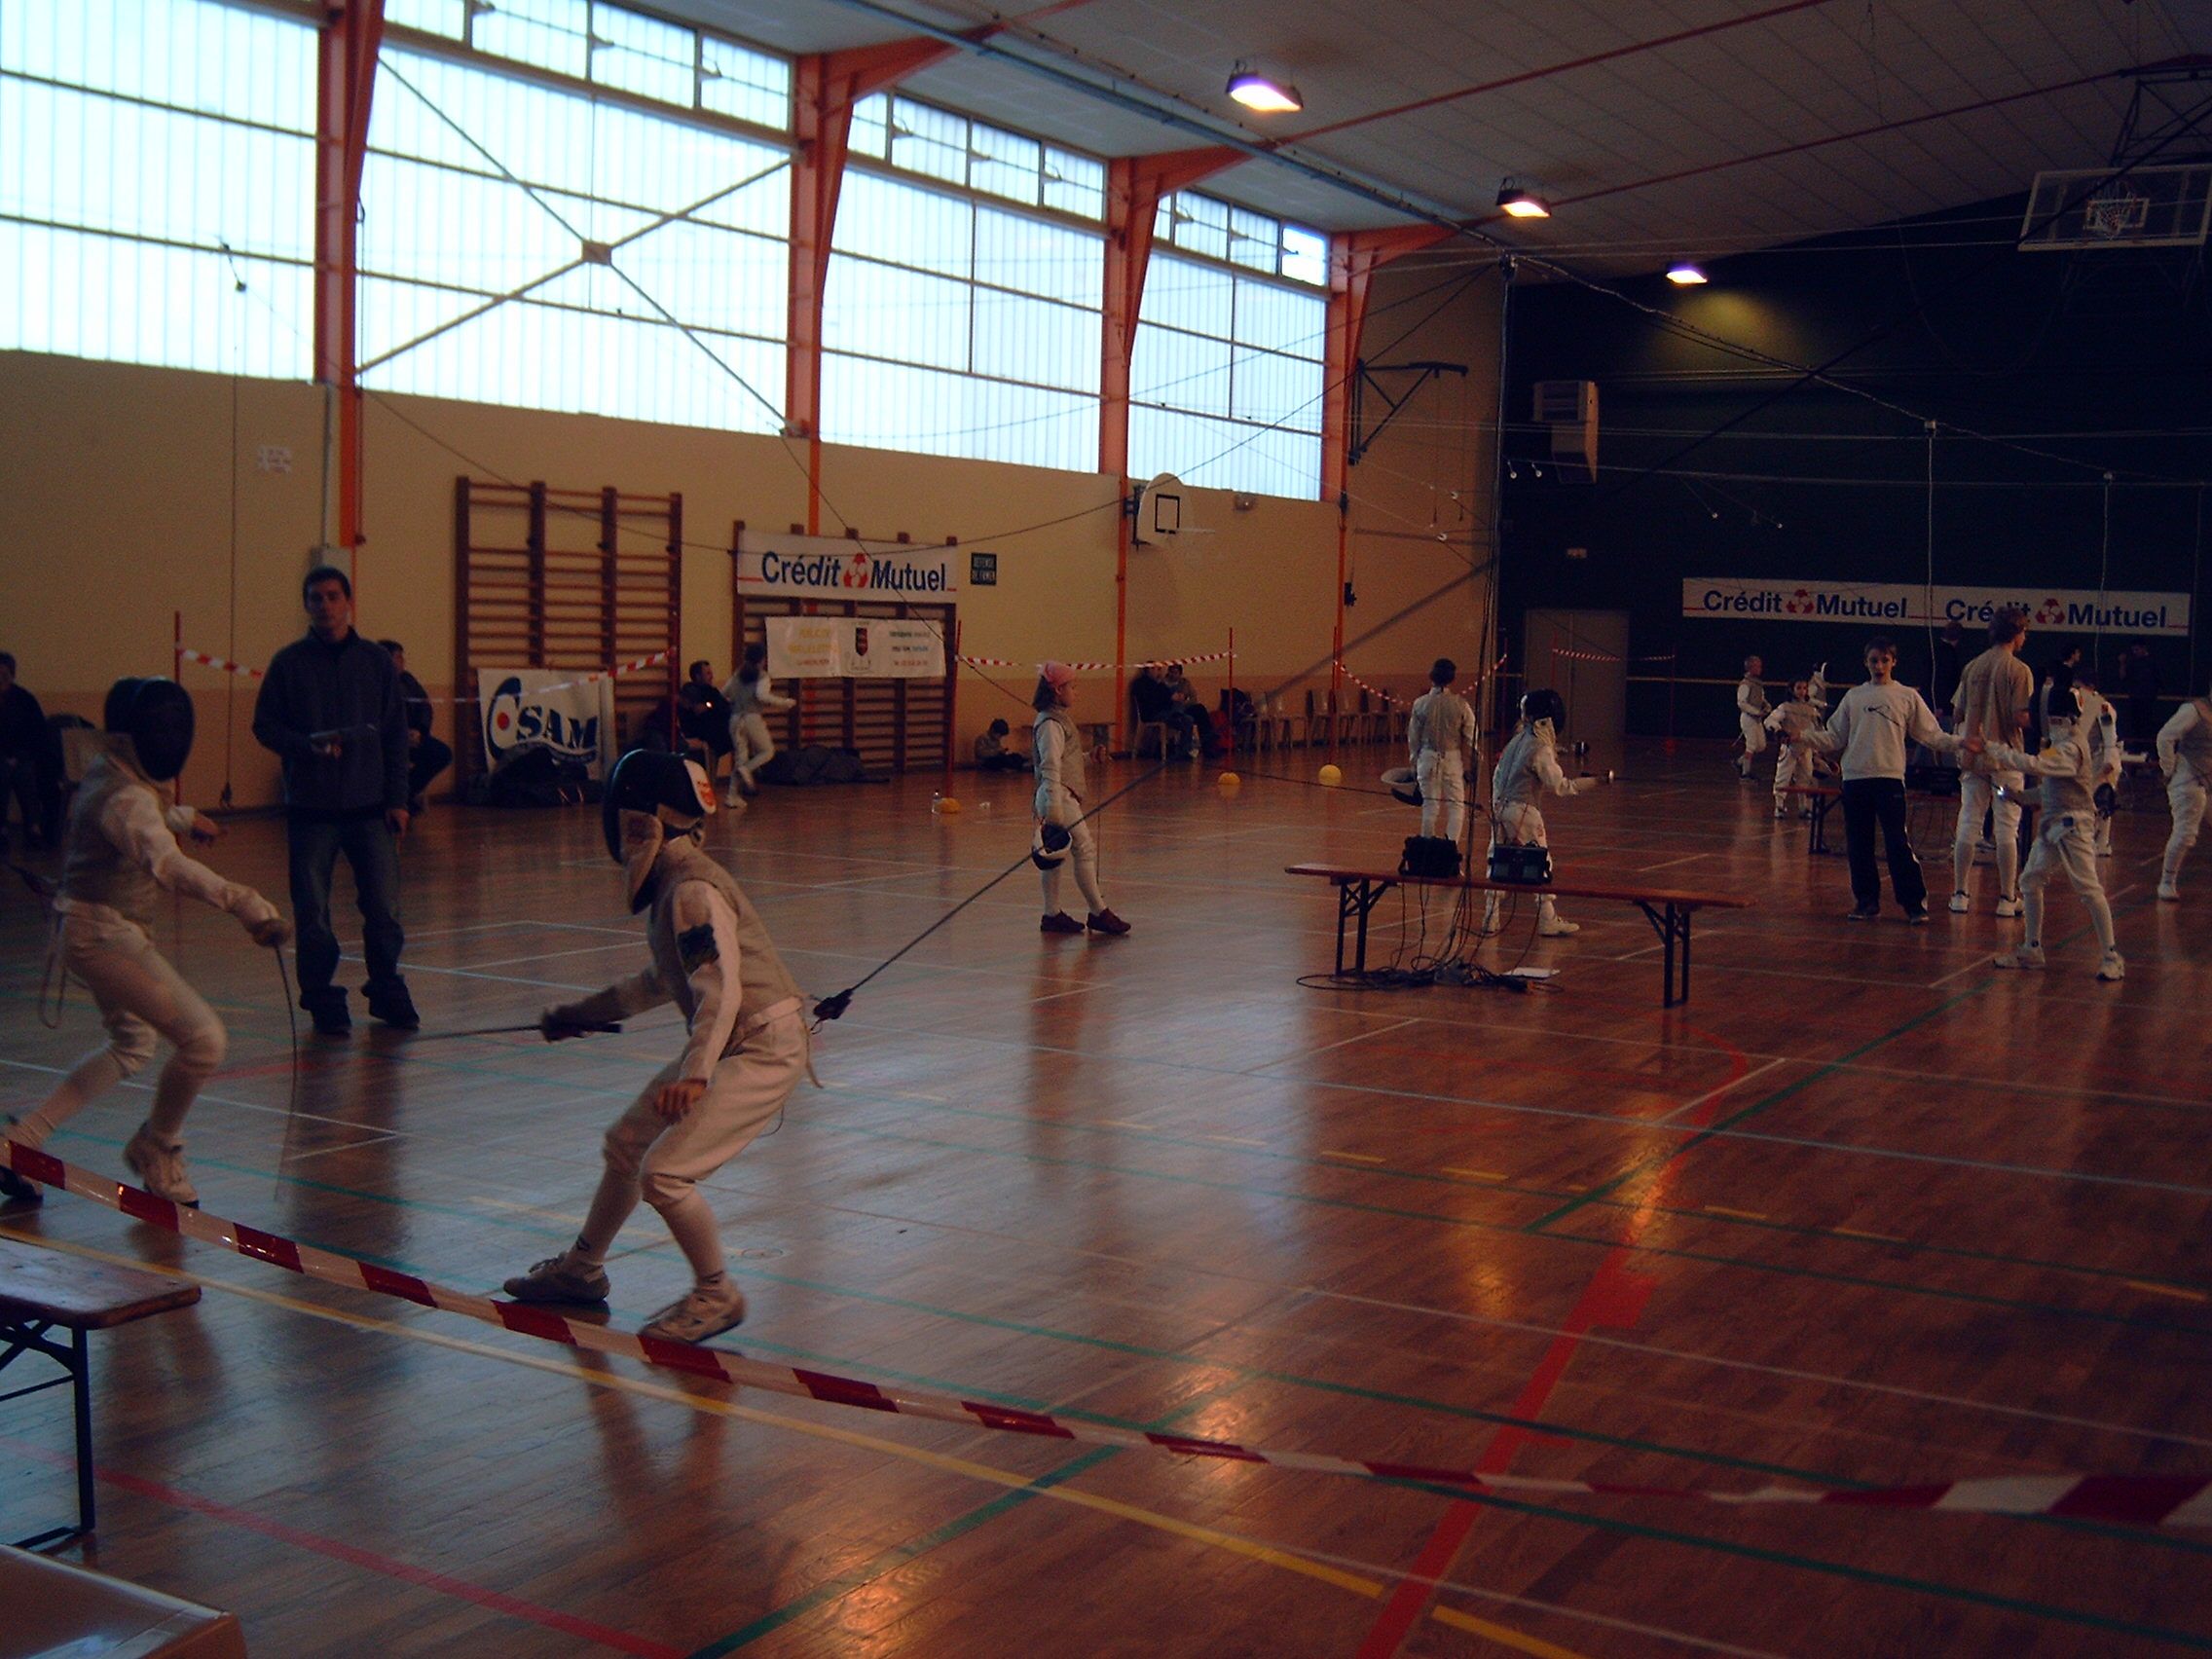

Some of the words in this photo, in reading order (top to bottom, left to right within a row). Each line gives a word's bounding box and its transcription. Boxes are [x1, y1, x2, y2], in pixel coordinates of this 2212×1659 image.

[761, 551, 841, 587] Crédit
[869, 560, 945, 591] Mutuel
[1704, 590, 1782, 613] Crédit
[1817, 594, 1907, 618] Mutuel
[1946, 599, 2031, 622] Crét
[2069, 604, 2166, 628] Mutuel
